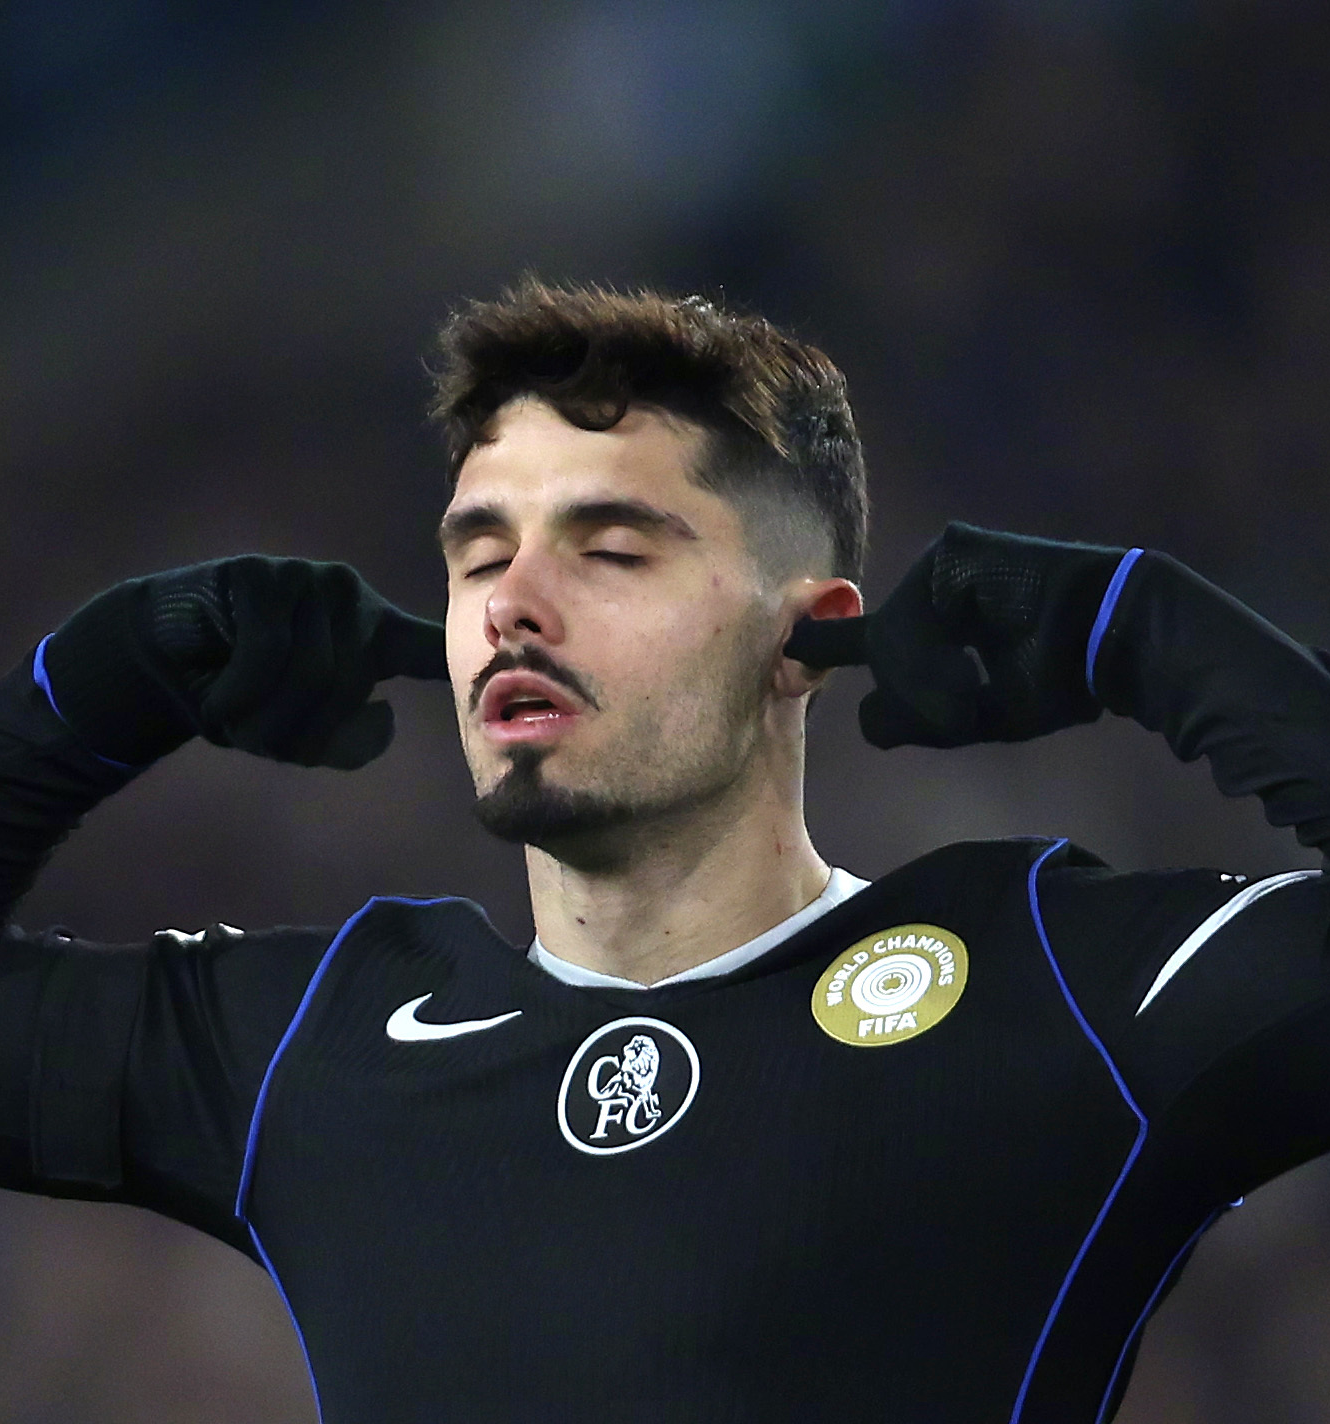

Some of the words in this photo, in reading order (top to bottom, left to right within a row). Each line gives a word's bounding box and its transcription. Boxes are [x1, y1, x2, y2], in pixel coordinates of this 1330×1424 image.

[826, 951, 870, 1007] WORLD
[873, 934, 956, 987] CHAMPIONS
[858, 1012, 917, 1038] FIFA
